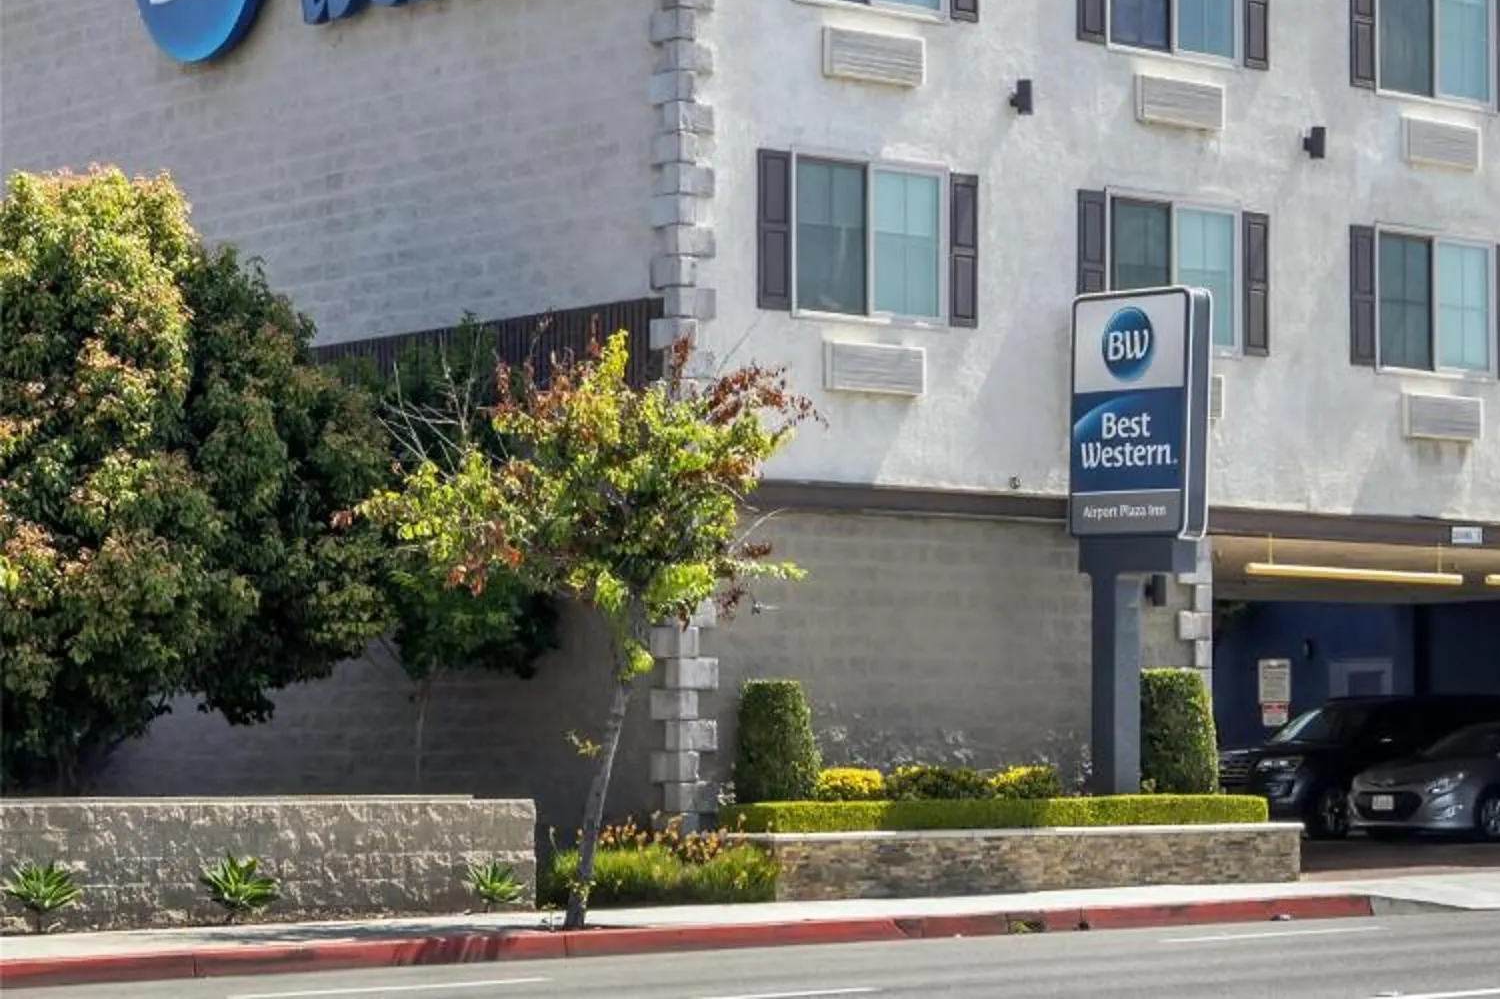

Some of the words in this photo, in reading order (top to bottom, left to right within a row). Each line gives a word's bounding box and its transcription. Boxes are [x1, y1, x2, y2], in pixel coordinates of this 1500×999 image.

[1107, 329, 1149, 361] BW
[1101, 411, 1151, 440] Best
[1083, 504, 1118, 521] Airport
[1119, 504, 1147, 517] Plaza
